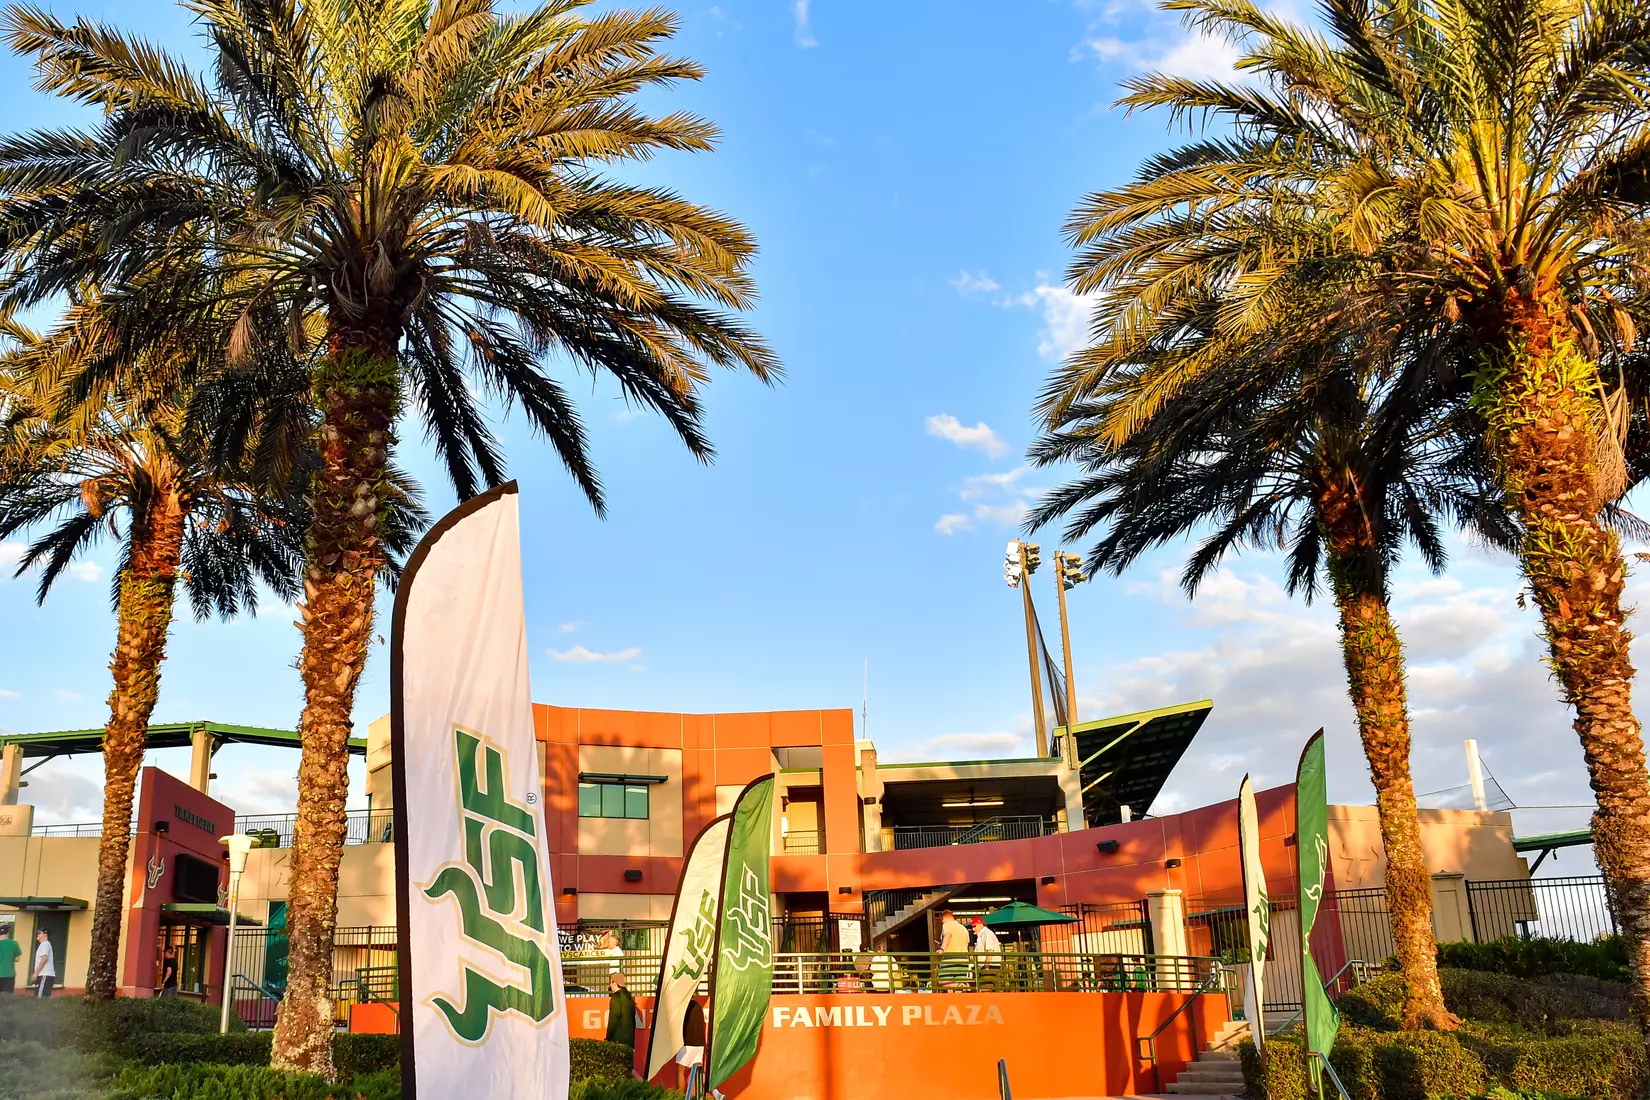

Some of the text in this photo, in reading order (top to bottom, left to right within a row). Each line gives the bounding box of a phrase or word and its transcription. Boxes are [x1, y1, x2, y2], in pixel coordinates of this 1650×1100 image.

[418, 726, 559, 1044] USF
[559, 934, 602, 943] WE PLAY
[672, 889, 716, 980] USF
[721, 861, 772, 970] USF
[574, 943, 595, 951] WIN
[773, 1005, 1004, 1028] FAMILY PLAZA
